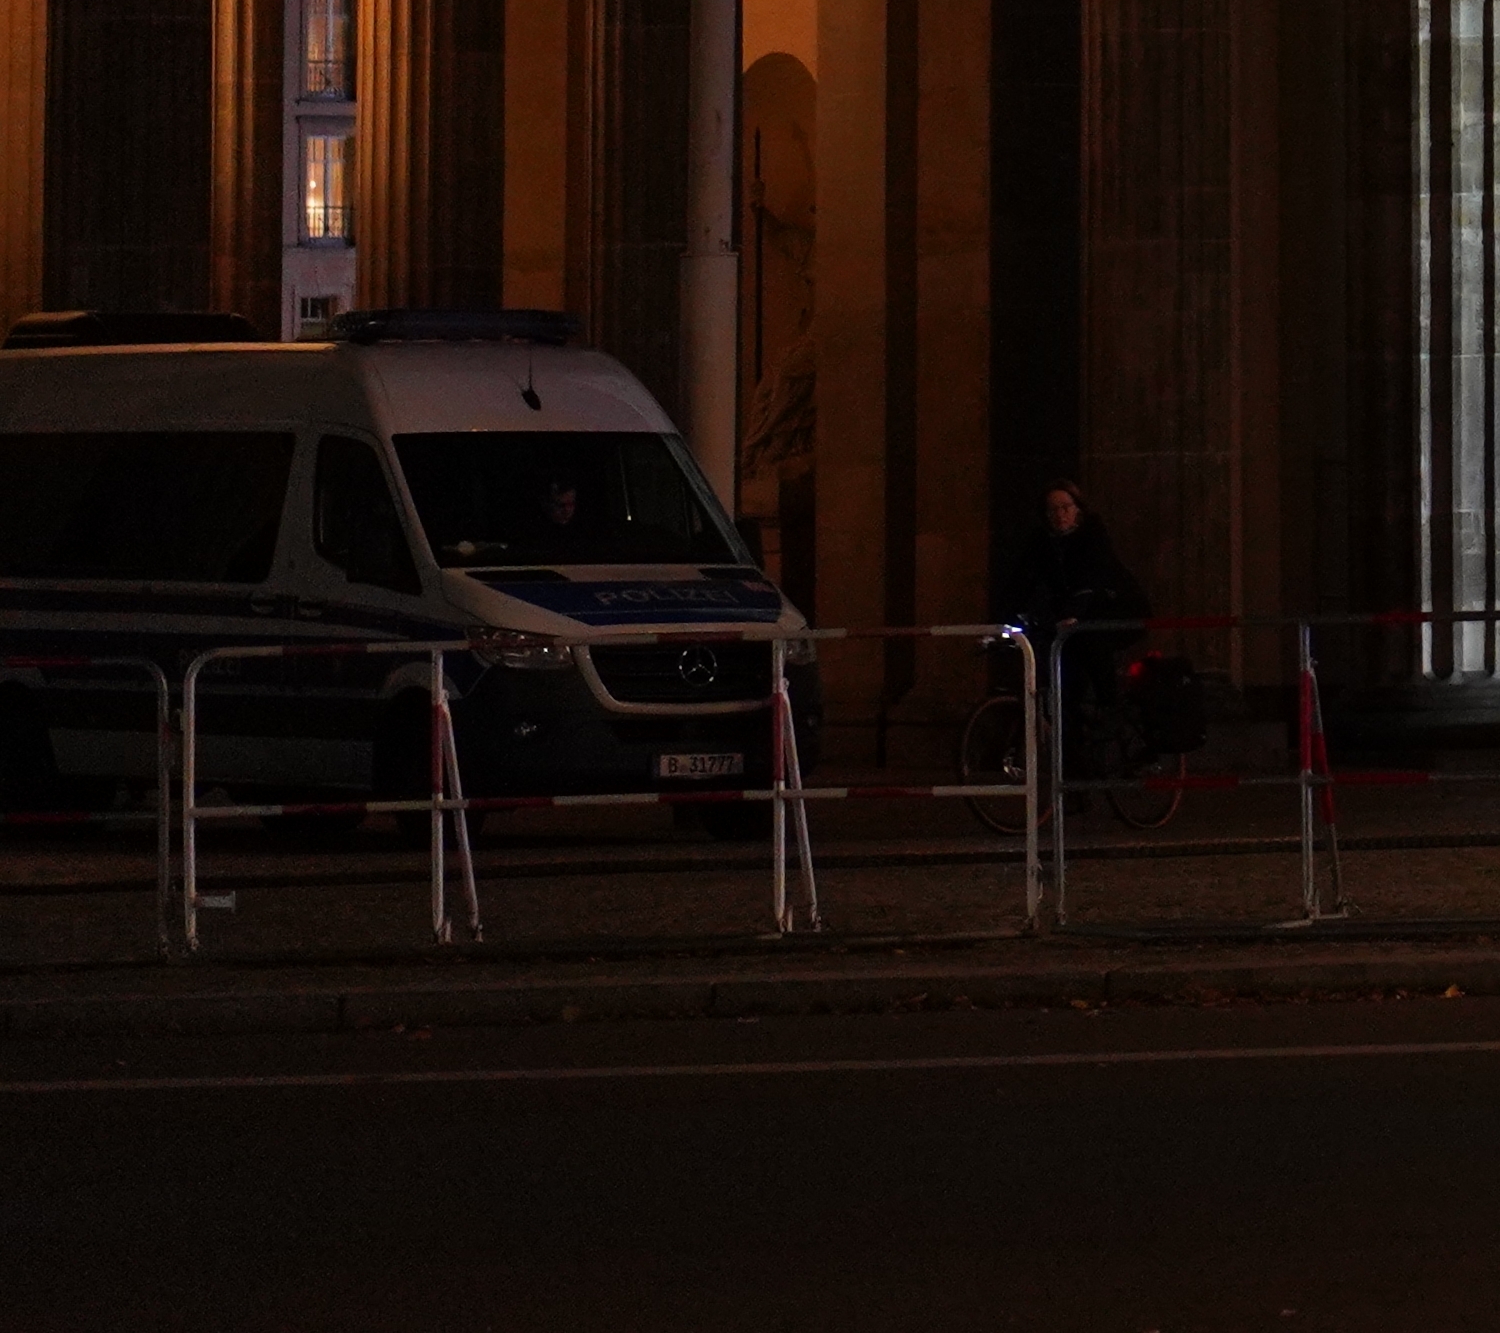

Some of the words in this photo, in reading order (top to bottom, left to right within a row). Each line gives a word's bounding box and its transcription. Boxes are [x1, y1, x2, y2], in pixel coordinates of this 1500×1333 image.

[594, 587, 739, 606] POLIZEI
[668, 757, 678, 773] B
[690, 755, 733, 773] 31777
